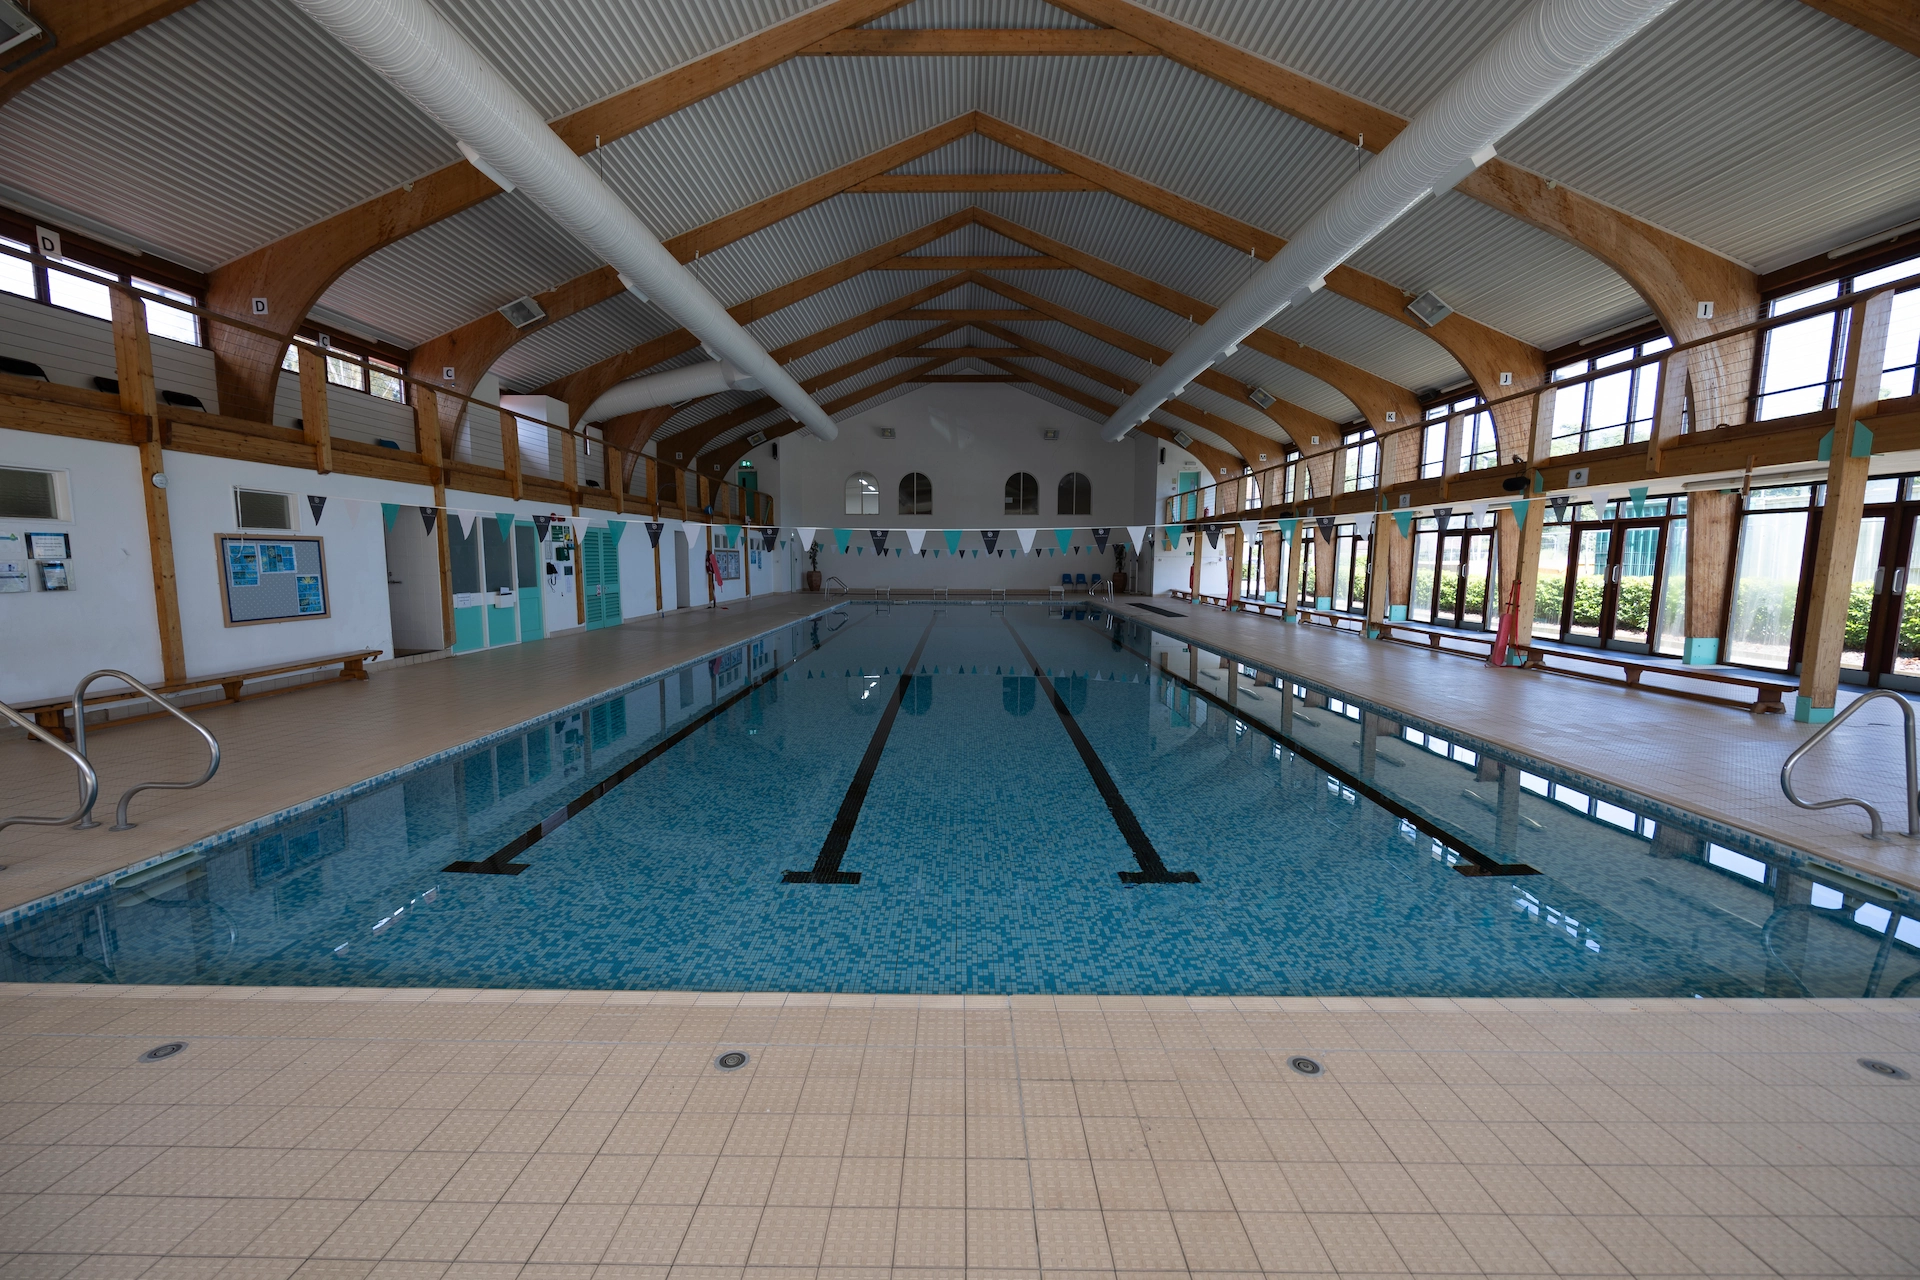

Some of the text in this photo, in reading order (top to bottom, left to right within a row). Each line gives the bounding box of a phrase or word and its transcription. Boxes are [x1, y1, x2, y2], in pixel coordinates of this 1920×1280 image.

[42, 236, 54, 251] D
[255, 300, 265, 312] D
[322, 336, 328, 347] C
[446, 369, 453, 378] C
[1503, 374, 1508, 383] J
